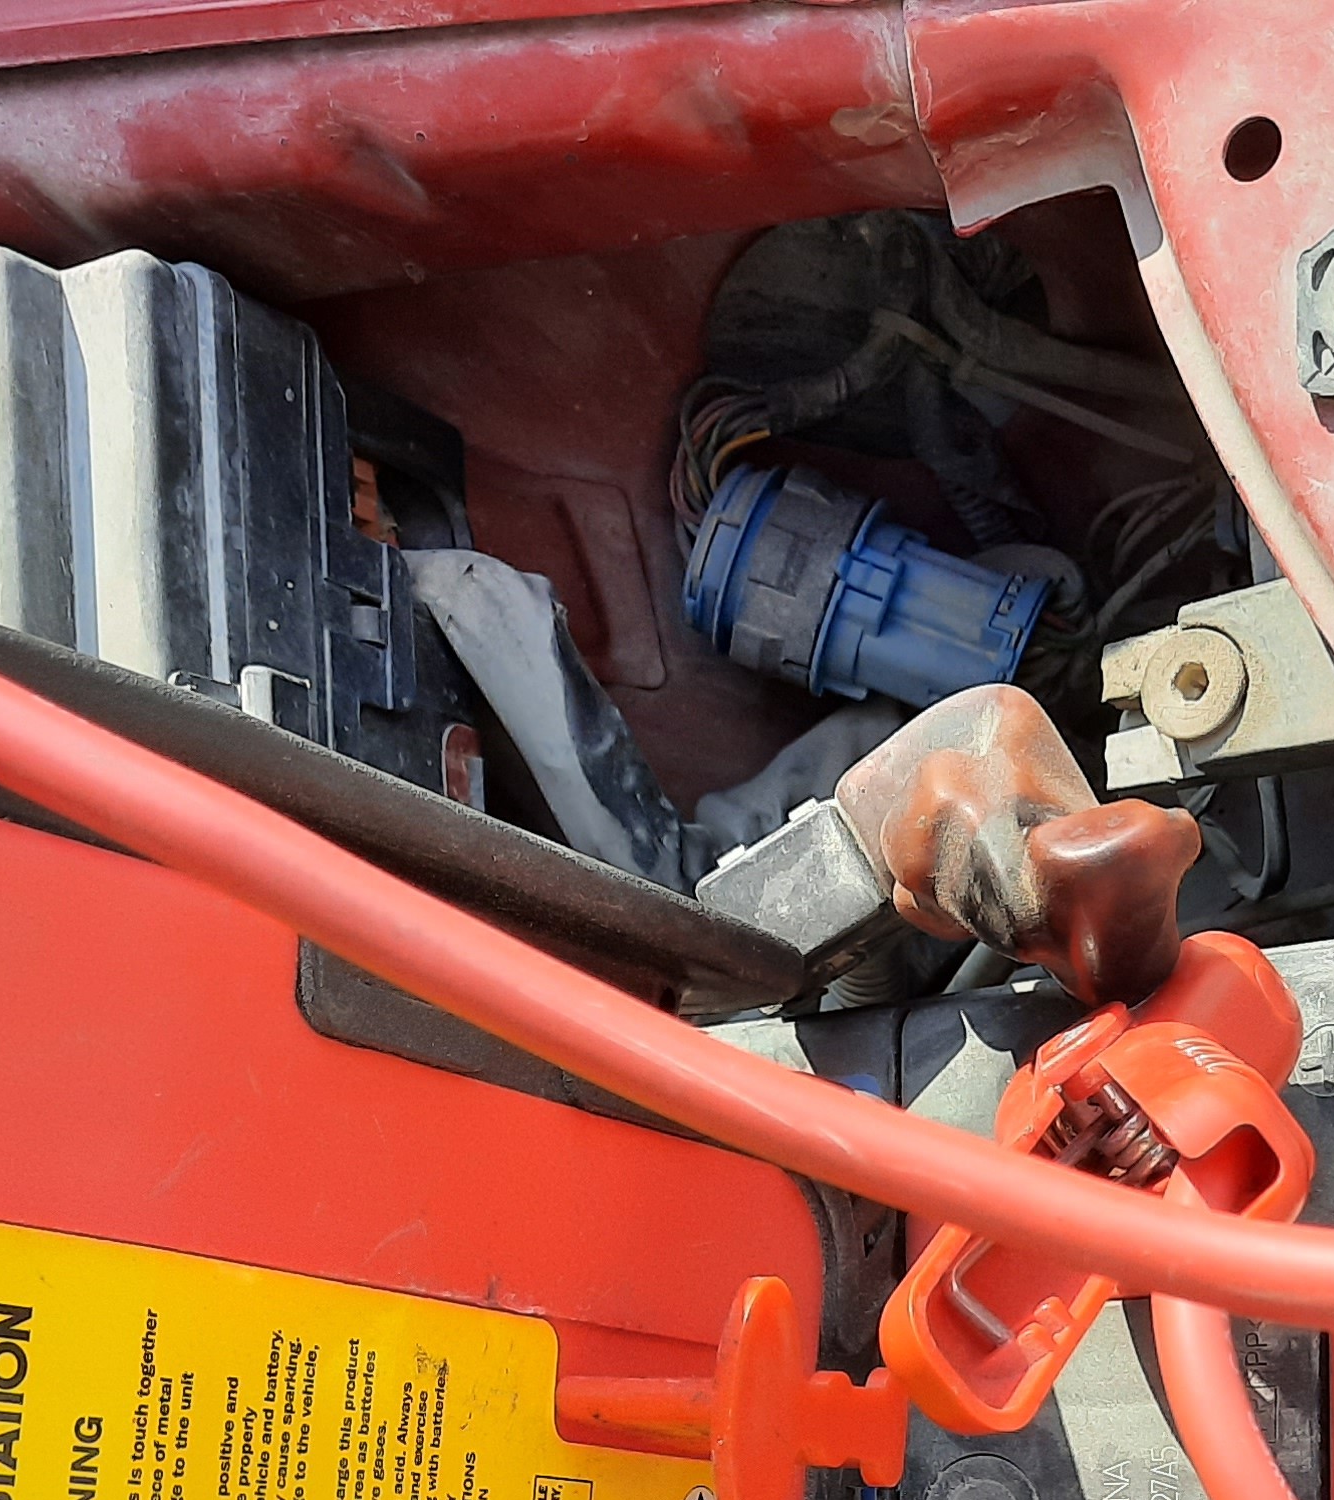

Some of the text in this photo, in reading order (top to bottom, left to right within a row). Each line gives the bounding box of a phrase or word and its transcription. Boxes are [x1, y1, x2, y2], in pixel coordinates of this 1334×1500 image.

[136, 1307, 158, 1398] together
[157, 1376, 173, 1435] metal
[179, 1371, 194, 1410] unit
[225, 1376, 239, 1414] and
[130, 1403, 149, 1462] touch
[152, 1439, 166, 1462] of
[174, 1416, 190, 1450] the
[238, 1405, 258, 1487] properly
[171, 1456, 185, 1478] to
[217, 1419, 235, 1496] positive
